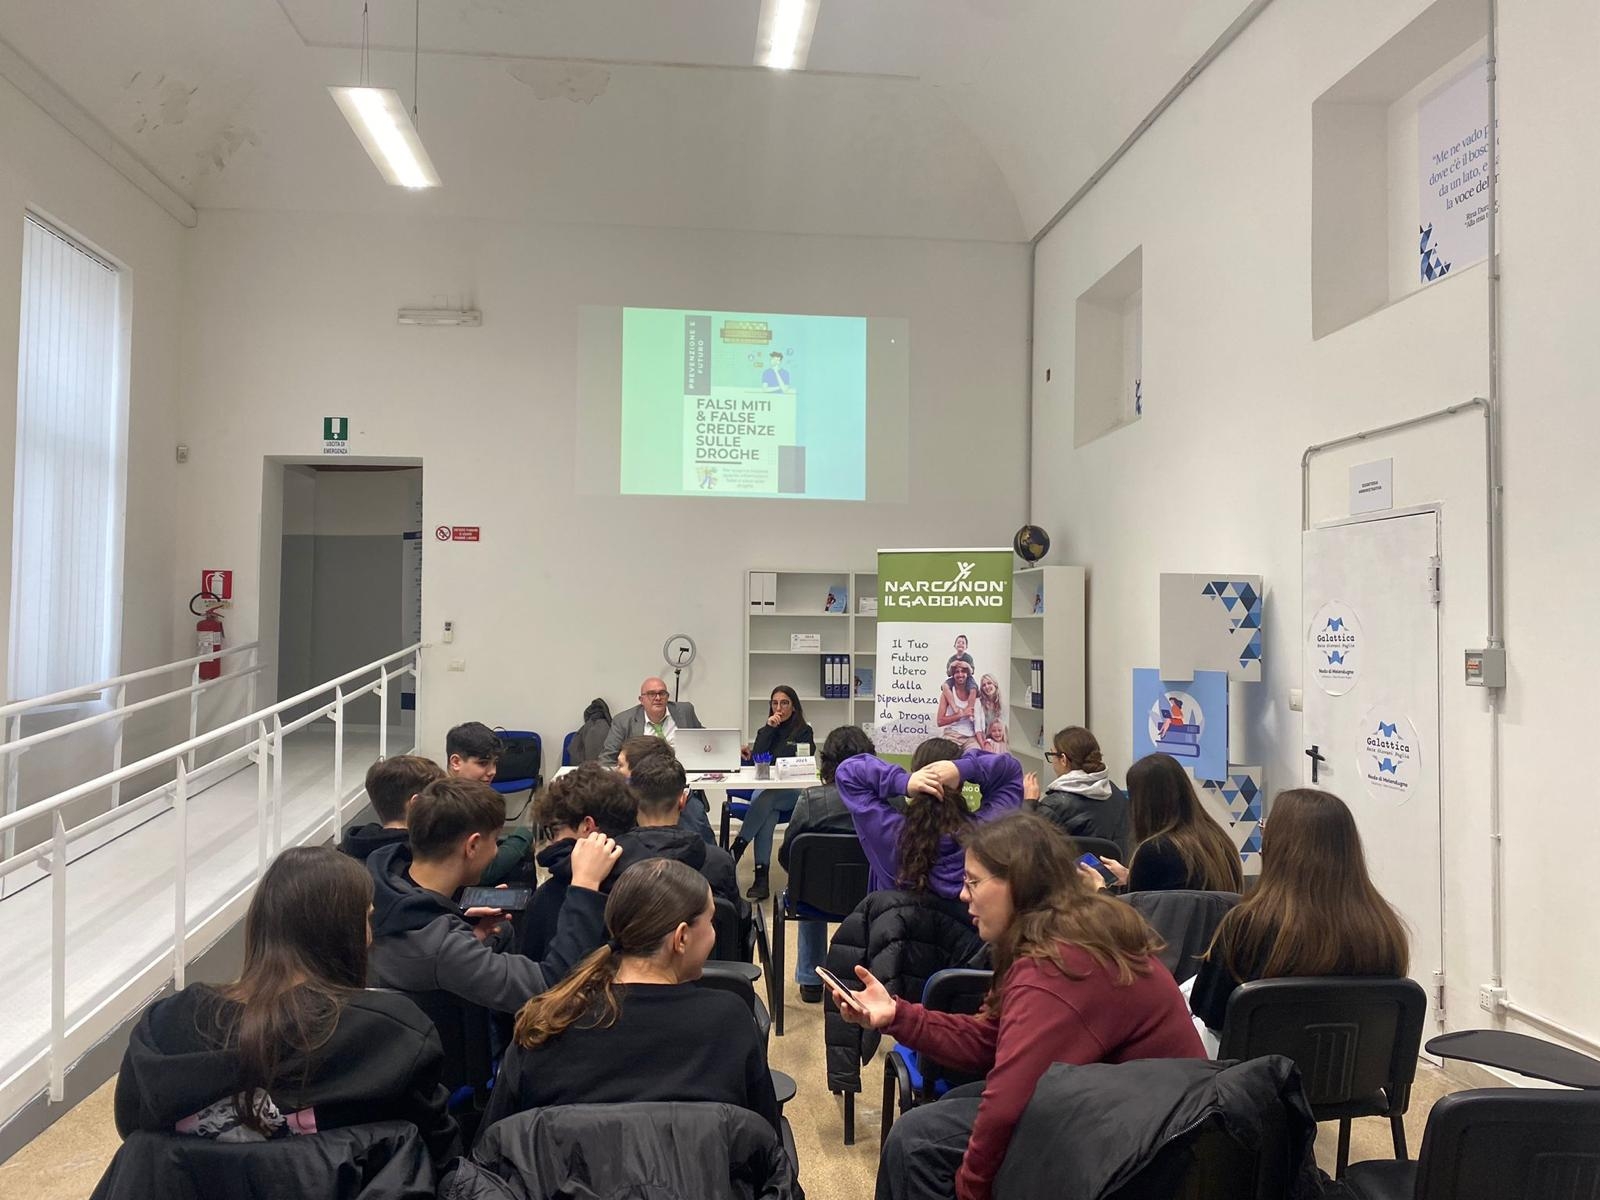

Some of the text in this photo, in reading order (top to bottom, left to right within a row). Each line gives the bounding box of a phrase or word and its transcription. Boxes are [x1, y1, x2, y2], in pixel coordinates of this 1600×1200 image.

[1450, 144, 1460, 156] ne
[1462, 129, 1482, 147] vado
[1429, 167, 1448, 186] dove
[1462, 153, 1468, 166] il
[1468, 143, 1490, 159] bosc
[1438, 184, 1448, 197] da
[1450, 178, 1461, 190] un
[1446, 199, 1454, 210] la
[1454, 187, 1474, 204] voce
[696, 398, 771, 412] FALSI MITI
[696, 410, 756, 423] & FALSE
[696, 423, 776, 436] CREDENZE
[696, 436, 741, 447] SULLE
[696, 448, 760, 460] DROGHE
[884, 580, 1004, 592] NARCONON
[884, 596, 1003, 608] IL GABBIANO
[1317, 633, 1355, 642] Galattica
[892, 640, 928, 648] Il Tuo
[892, 652, 928, 662] Futuro
[892, 665, 926, 676] Libero
[892, 680, 922, 690] dalla
[877, 694, 939, 708] Dipendenza
[880, 709, 930, 724] da Droga
[892, 724, 928, 734] Alcool
[1366, 737, 1410, 752] Galattica
